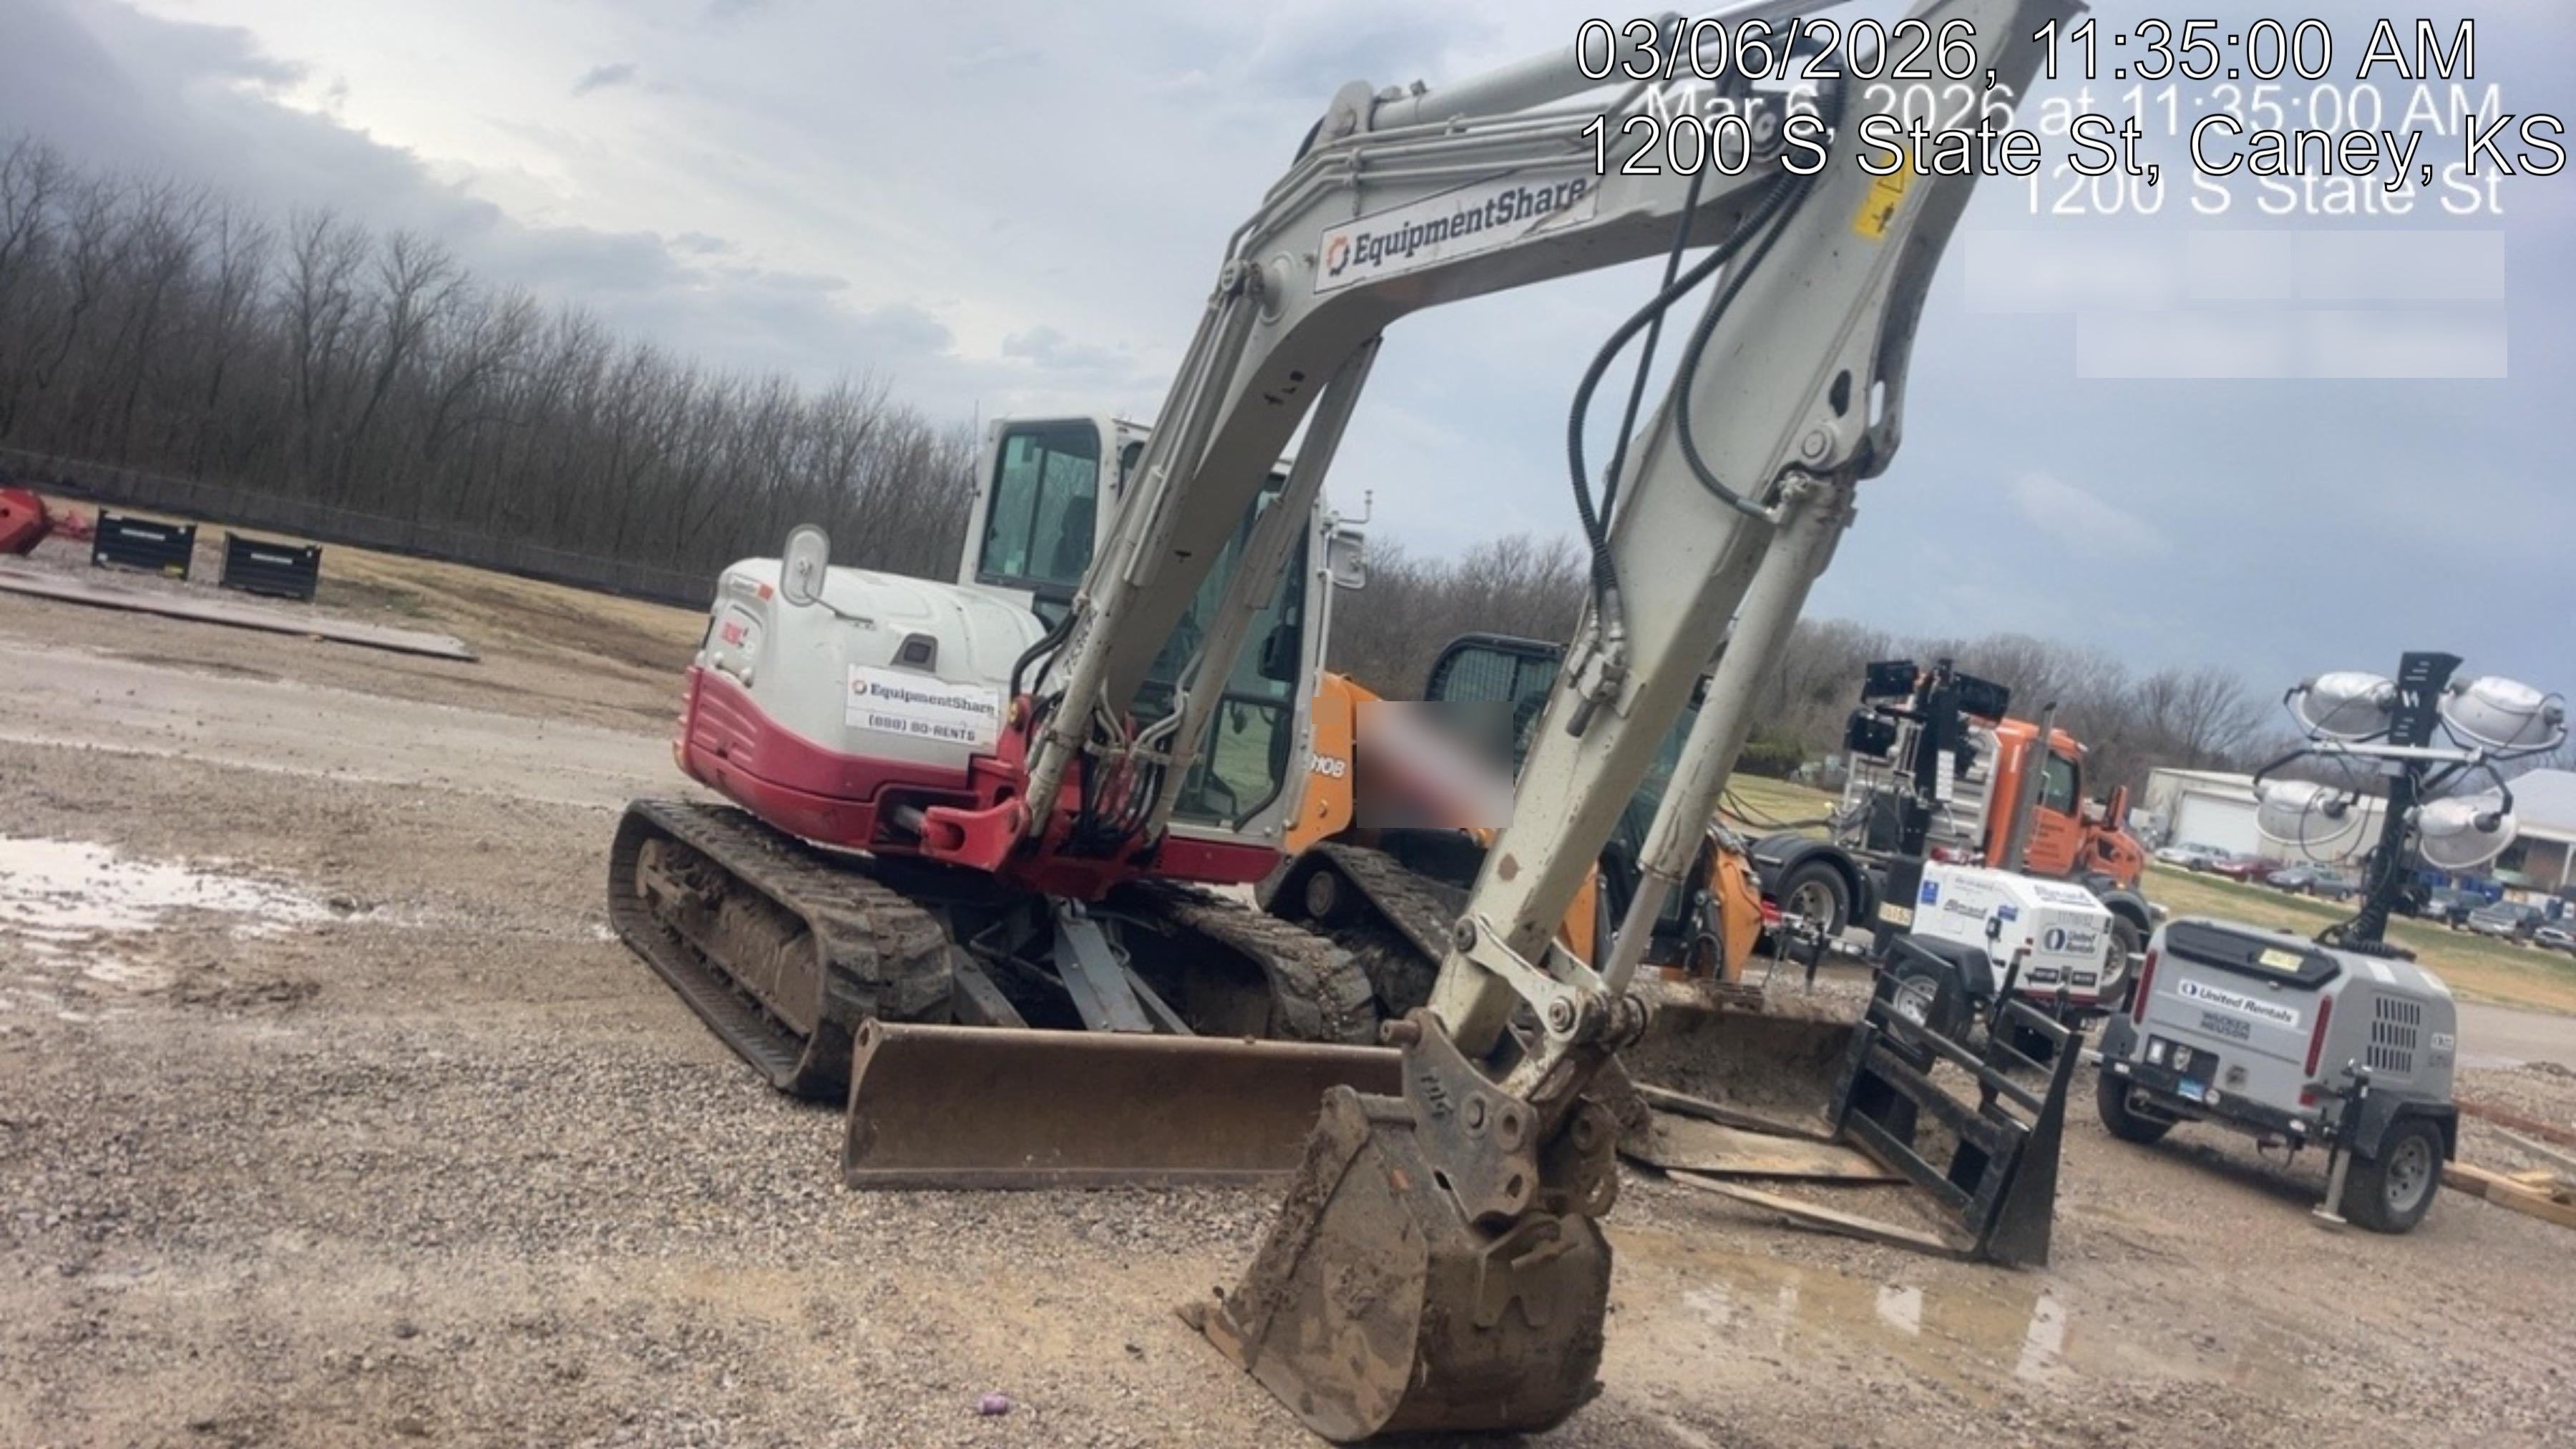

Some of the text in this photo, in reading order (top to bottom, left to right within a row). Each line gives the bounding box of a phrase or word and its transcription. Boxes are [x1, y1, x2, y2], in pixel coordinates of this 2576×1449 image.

[1352, 177, 1587, 267] EquipmentShare
[870, 683, 995, 714] EquipmentShare
[2200, 987, 2293, 1023] United Rentals
